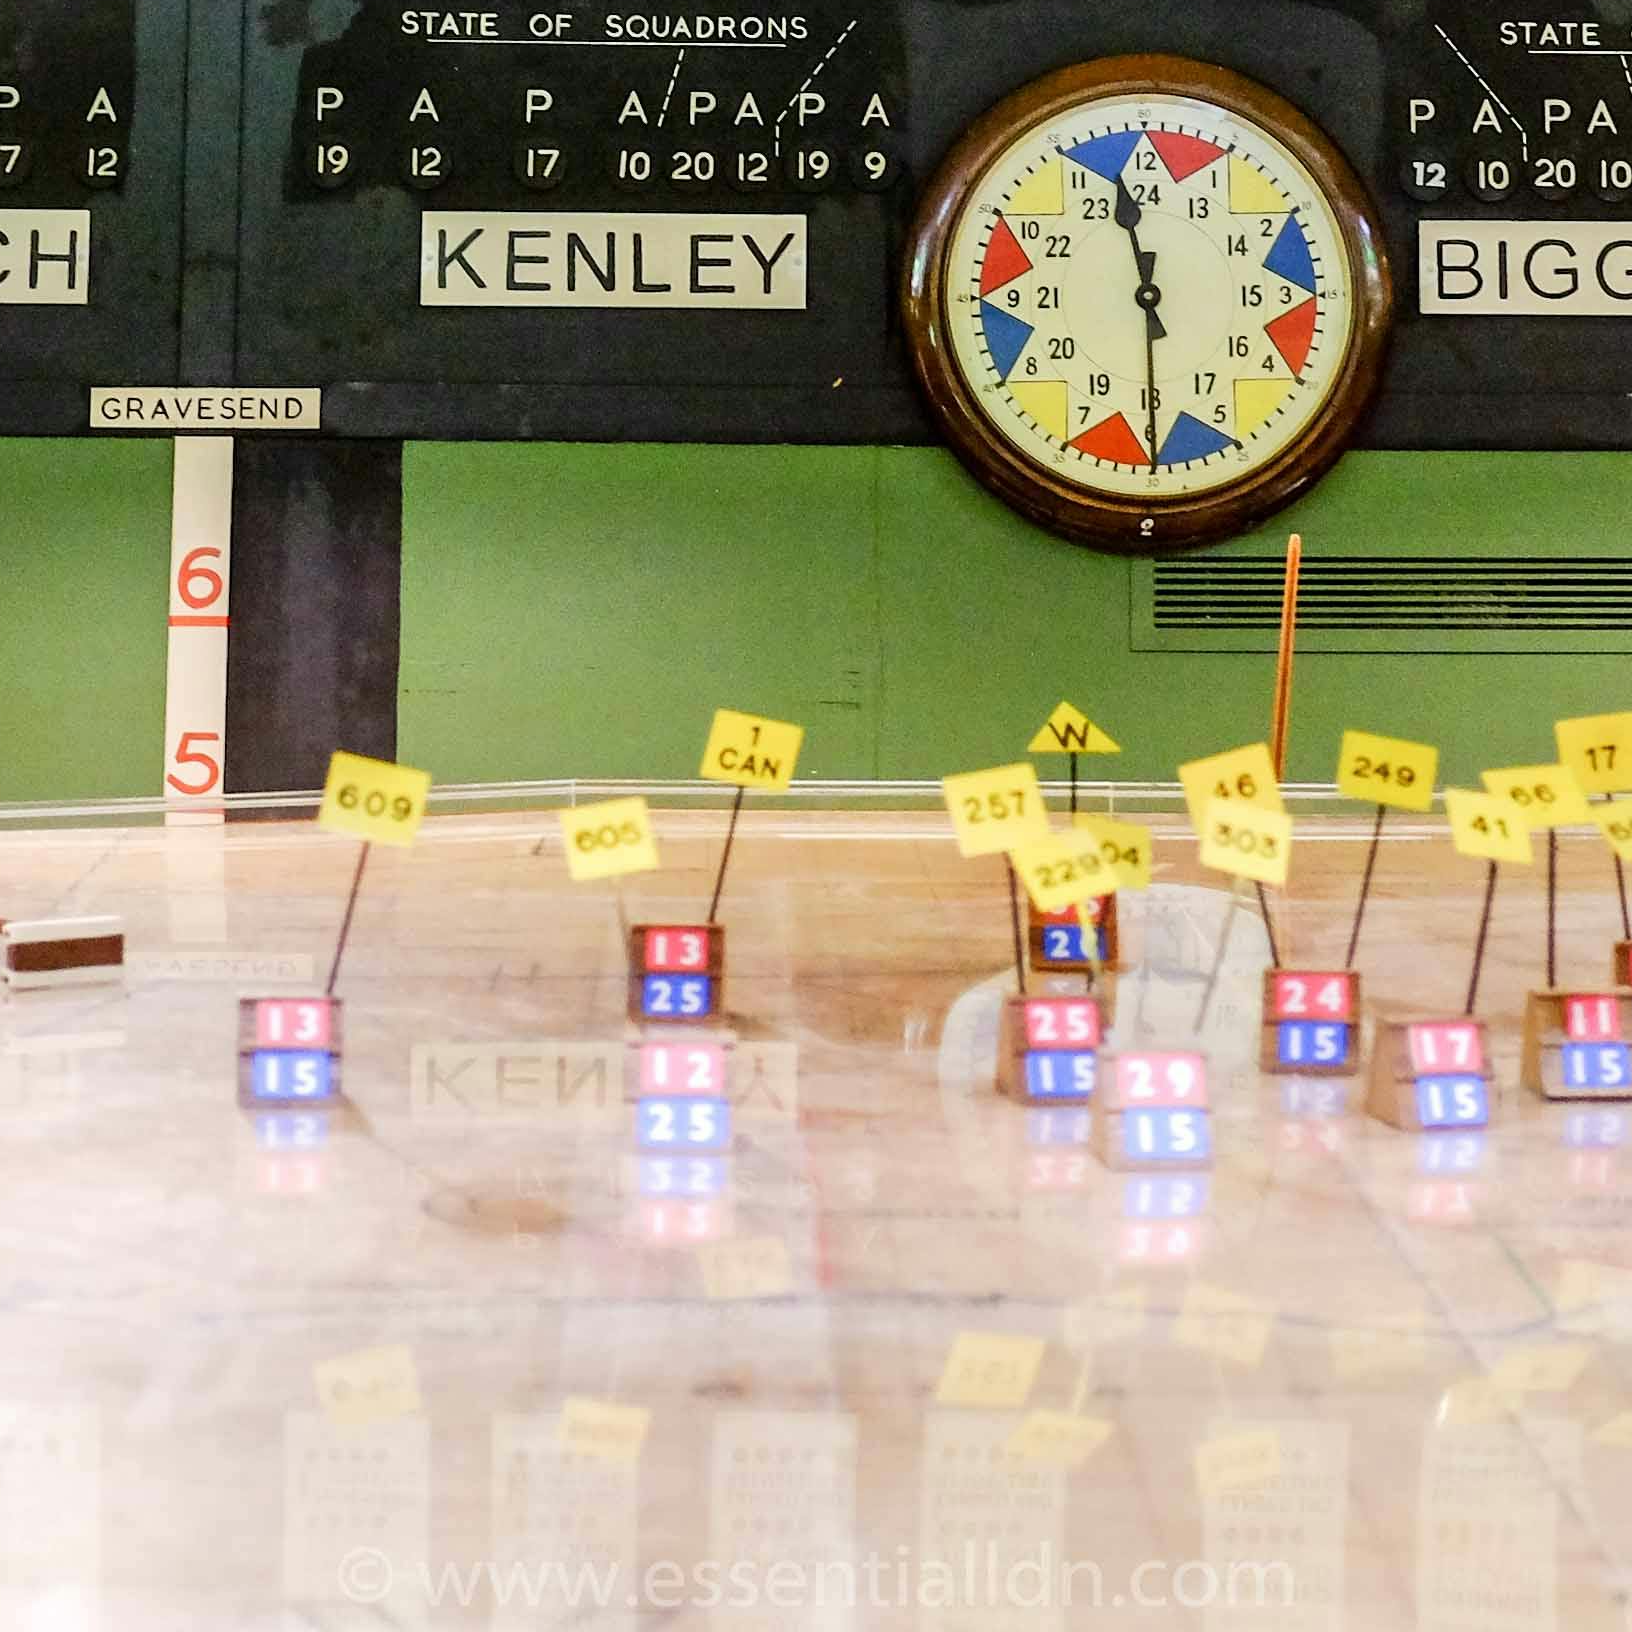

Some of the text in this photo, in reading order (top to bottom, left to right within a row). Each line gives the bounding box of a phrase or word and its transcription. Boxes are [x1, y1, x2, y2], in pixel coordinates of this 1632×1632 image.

[402, 11, 807, 39] STATE OF SQUADRONS
[1501, 22, 1600, 45] STATE
[318, 88, 552, 122] P A P
[318, 146, 714, 180] 19 12 17 10 20
[1136, 152, 1156, 170] 12
[1046, 235, 1070, 257] 22
[438, 229, 794, 294] KENLEY
[1038, 286, 1058, 308] 21
[1242, 285, 1262, 306] 15
[101, 397, 302, 420] GRAVESEND
[178, 547, 223, 609] 6
[753, 727, 760, 744] 1
[1048, 720, 1089, 749] W
[167, 732, 219, 795] 5
[719, 748, 778, 778] CAN
[1353, 757, 1415, 787] 249
[1586, 745, 1616, 771] 17
[337, 784, 412, 821] 609
[965, 790, 1025, 823] 257
[656, 935, 700, 965] 13
[651, 981, 701, 1013] 25
[1284, 980, 1342, 1012] 24
[269, 1006, 318, 1040] 13
[1289, 1028, 1336, 1059] 15
[1421, 1031, 1470, 1064] 17
[266, 1059, 317, 1094] 15
